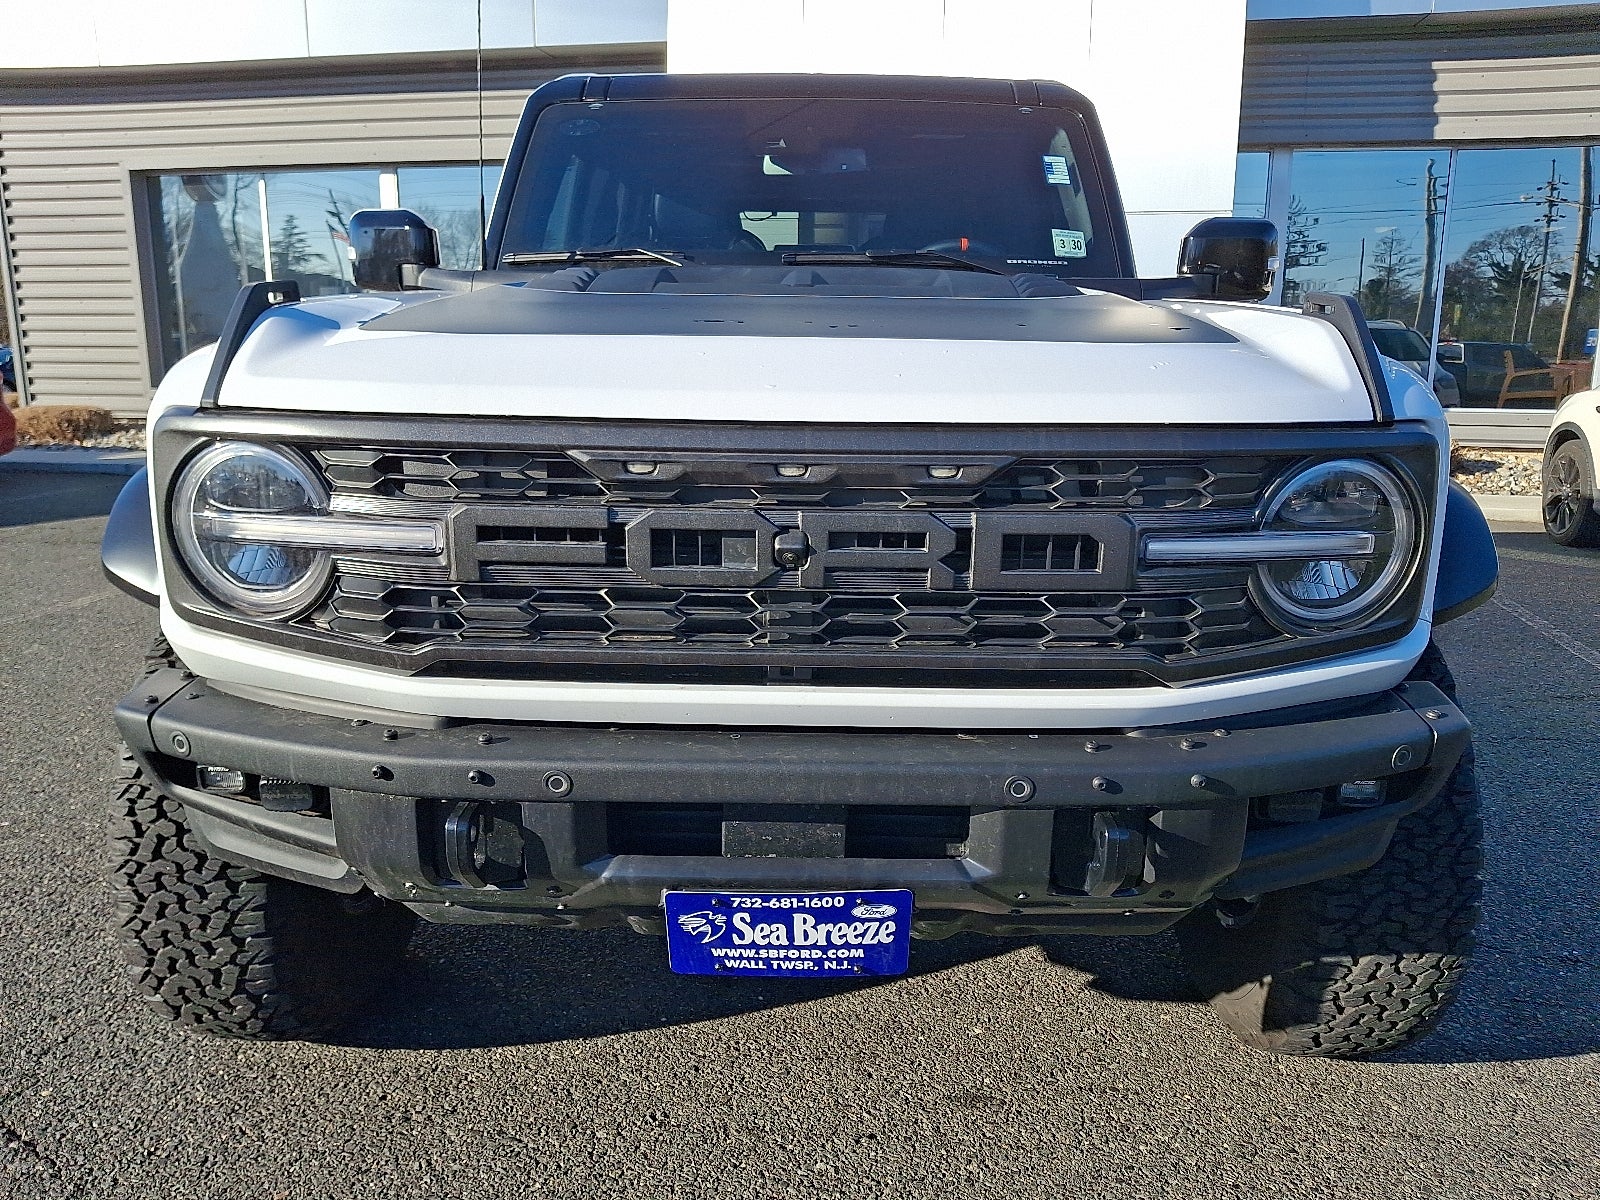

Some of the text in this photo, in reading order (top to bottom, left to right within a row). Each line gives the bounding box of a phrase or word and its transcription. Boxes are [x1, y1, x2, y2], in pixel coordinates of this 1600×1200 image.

[1060, 239, 1082, 251] 3 30
[449, 505, 1136, 591] FORD
[730, 896, 845, 909] 732-681-1600
[732, 912, 897, 946] Sea Breeze
[710, 948, 865, 959] WWW.SBFORD.COM
[724, 959, 767, 969] WALL
[824, 960, 852, 969] N.J.
